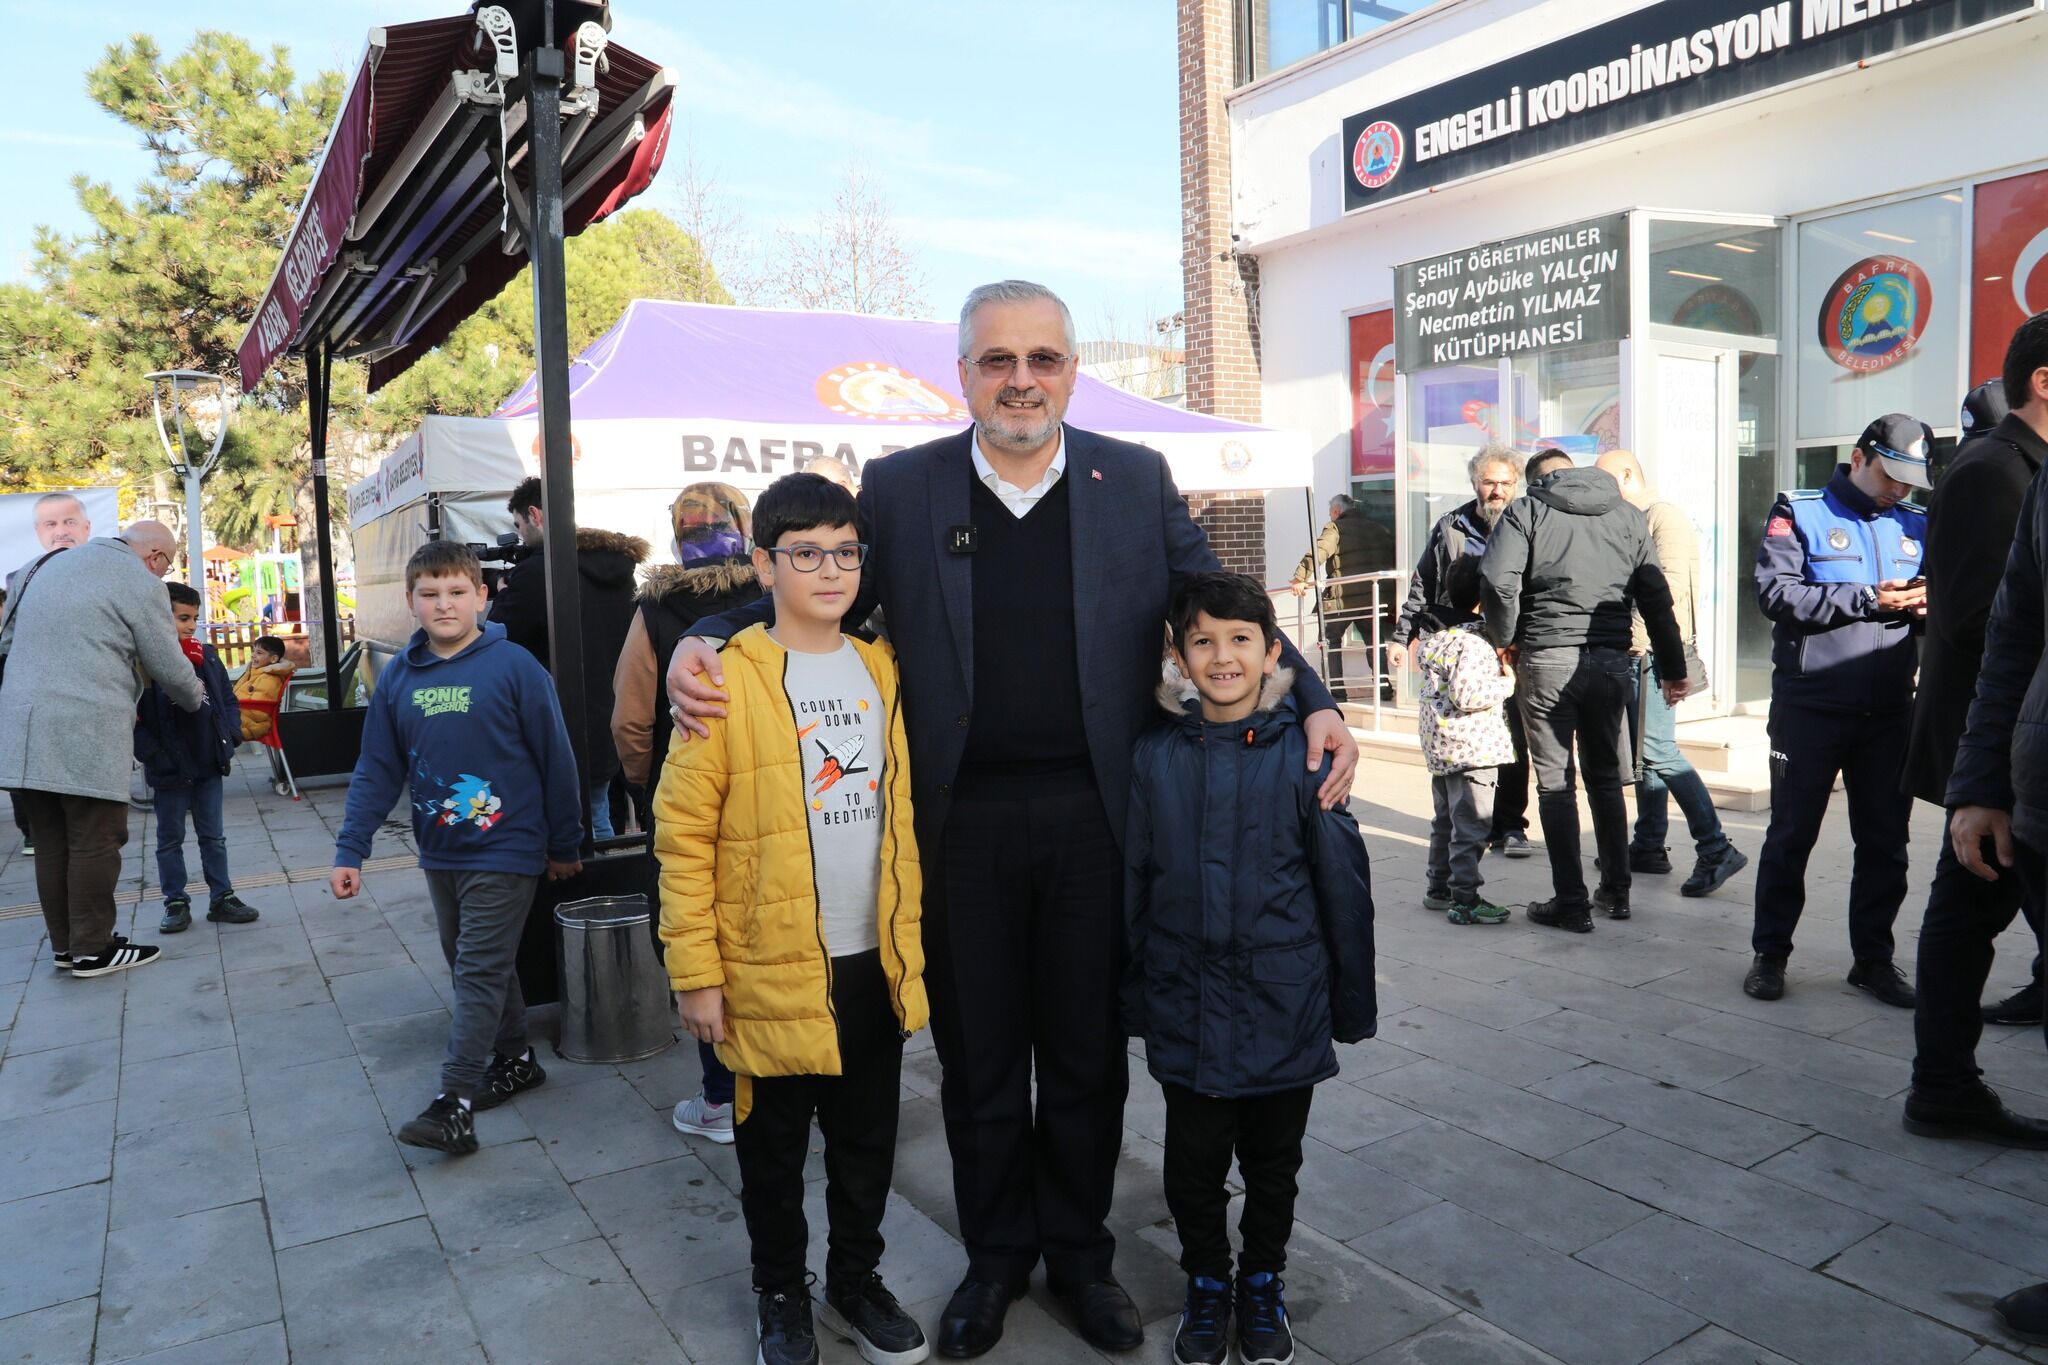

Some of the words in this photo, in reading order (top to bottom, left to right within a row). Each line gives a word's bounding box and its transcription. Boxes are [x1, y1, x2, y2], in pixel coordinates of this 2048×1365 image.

[1415, 86, 1521, 162] ENGELLİ
[1528, 1, 1791, 127] KOORDİNASYON
[1361, 124, 1393, 145] BAFRA
[1418, 256, 1463, 287] ŞEHİT
[1468, 227, 1601, 272] ÖĞRETMENLER
[1405, 286, 1459, 318] Şenay
[1463, 269, 1533, 303] Aybüke
[1541, 248, 1618, 284] YALÇIN
[1843, 260, 1910, 295] BAFRA
[1418, 301, 1515, 336] Necmettin
[1521, 283, 1602, 317] YILMAZ
[1433, 314, 1584, 363] KÜTÜPHANESİ
[681, 434, 862, 478] BAFRA
[412, 685, 472, 706] SONIC
[424, 700, 470, 718] HEDGEHOG
[800, 699, 844, 714] COUNT
[825, 712, 862, 728] DOWN
[845, 792, 861, 807] TO
